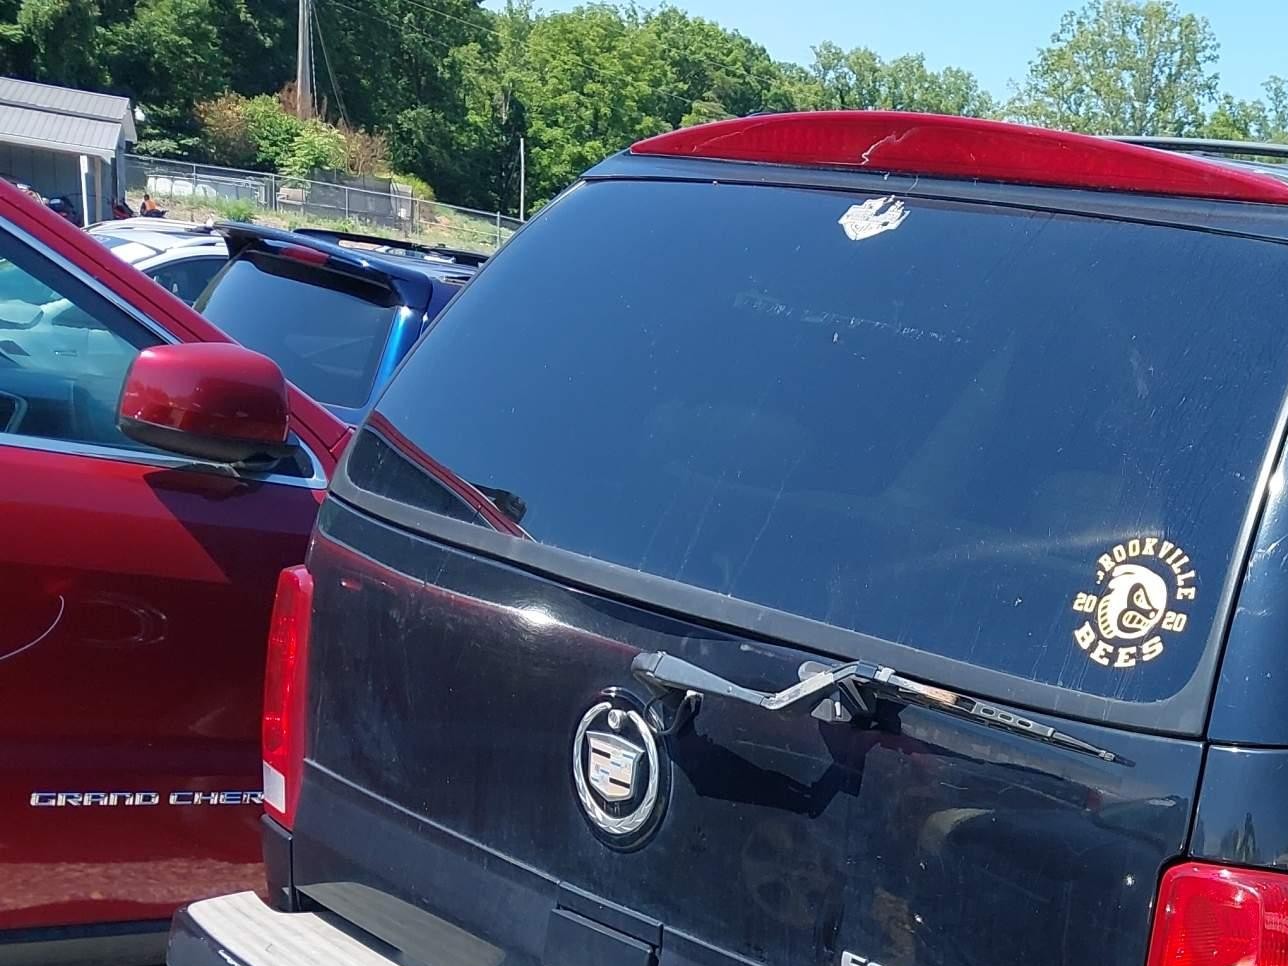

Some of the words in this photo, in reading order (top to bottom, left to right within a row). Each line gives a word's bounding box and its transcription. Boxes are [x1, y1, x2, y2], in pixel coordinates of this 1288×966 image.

[1072, 591, 1098, 613] 20
[1161, 611, 1188, 633] 20
[1074, 620, 1164, 668] BEES
[30, 791, 160, 807] GRAND
